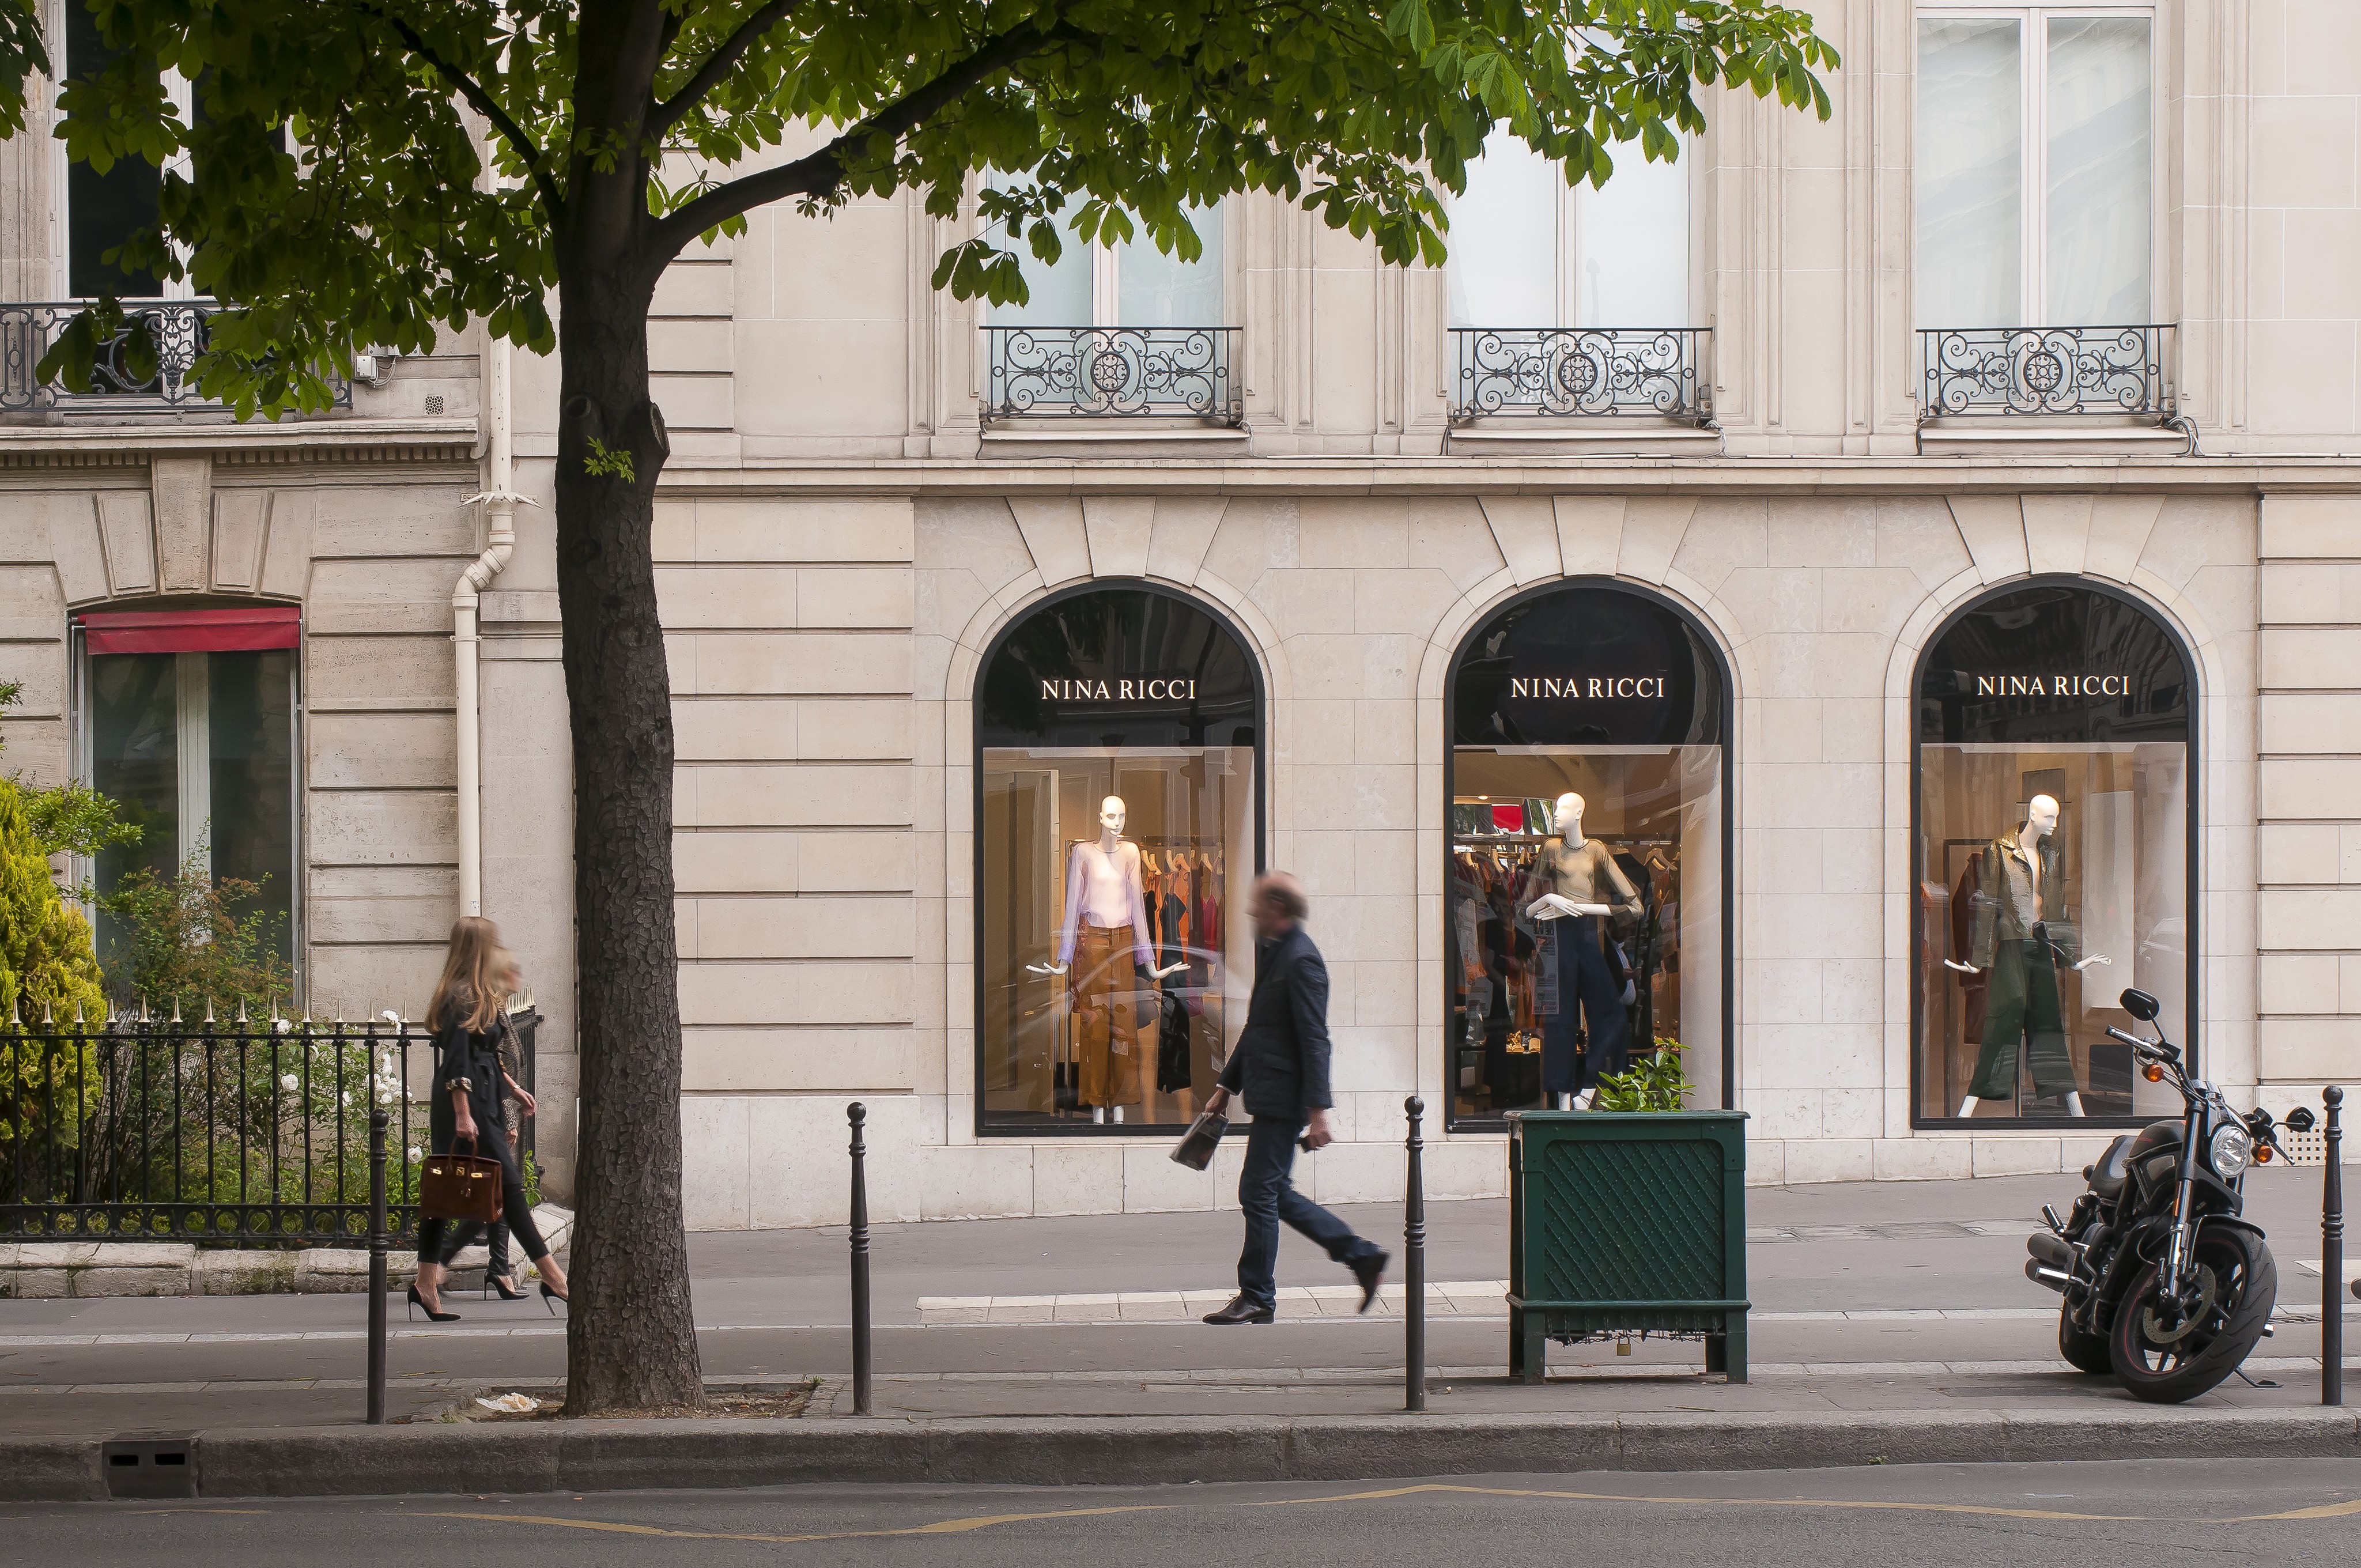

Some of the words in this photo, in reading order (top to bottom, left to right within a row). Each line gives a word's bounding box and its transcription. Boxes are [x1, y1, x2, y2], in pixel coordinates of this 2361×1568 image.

[1041, 679, 1111, 700] NINA
[1119, 679, 1195, 700] RICCI
[1511, 678, 1580, 698] NINA
[1588, 677, 1664, 698] RICCI
[1977, 676, 2046, 696] NINA
[2054, 675, 2129, 696] RICCI
